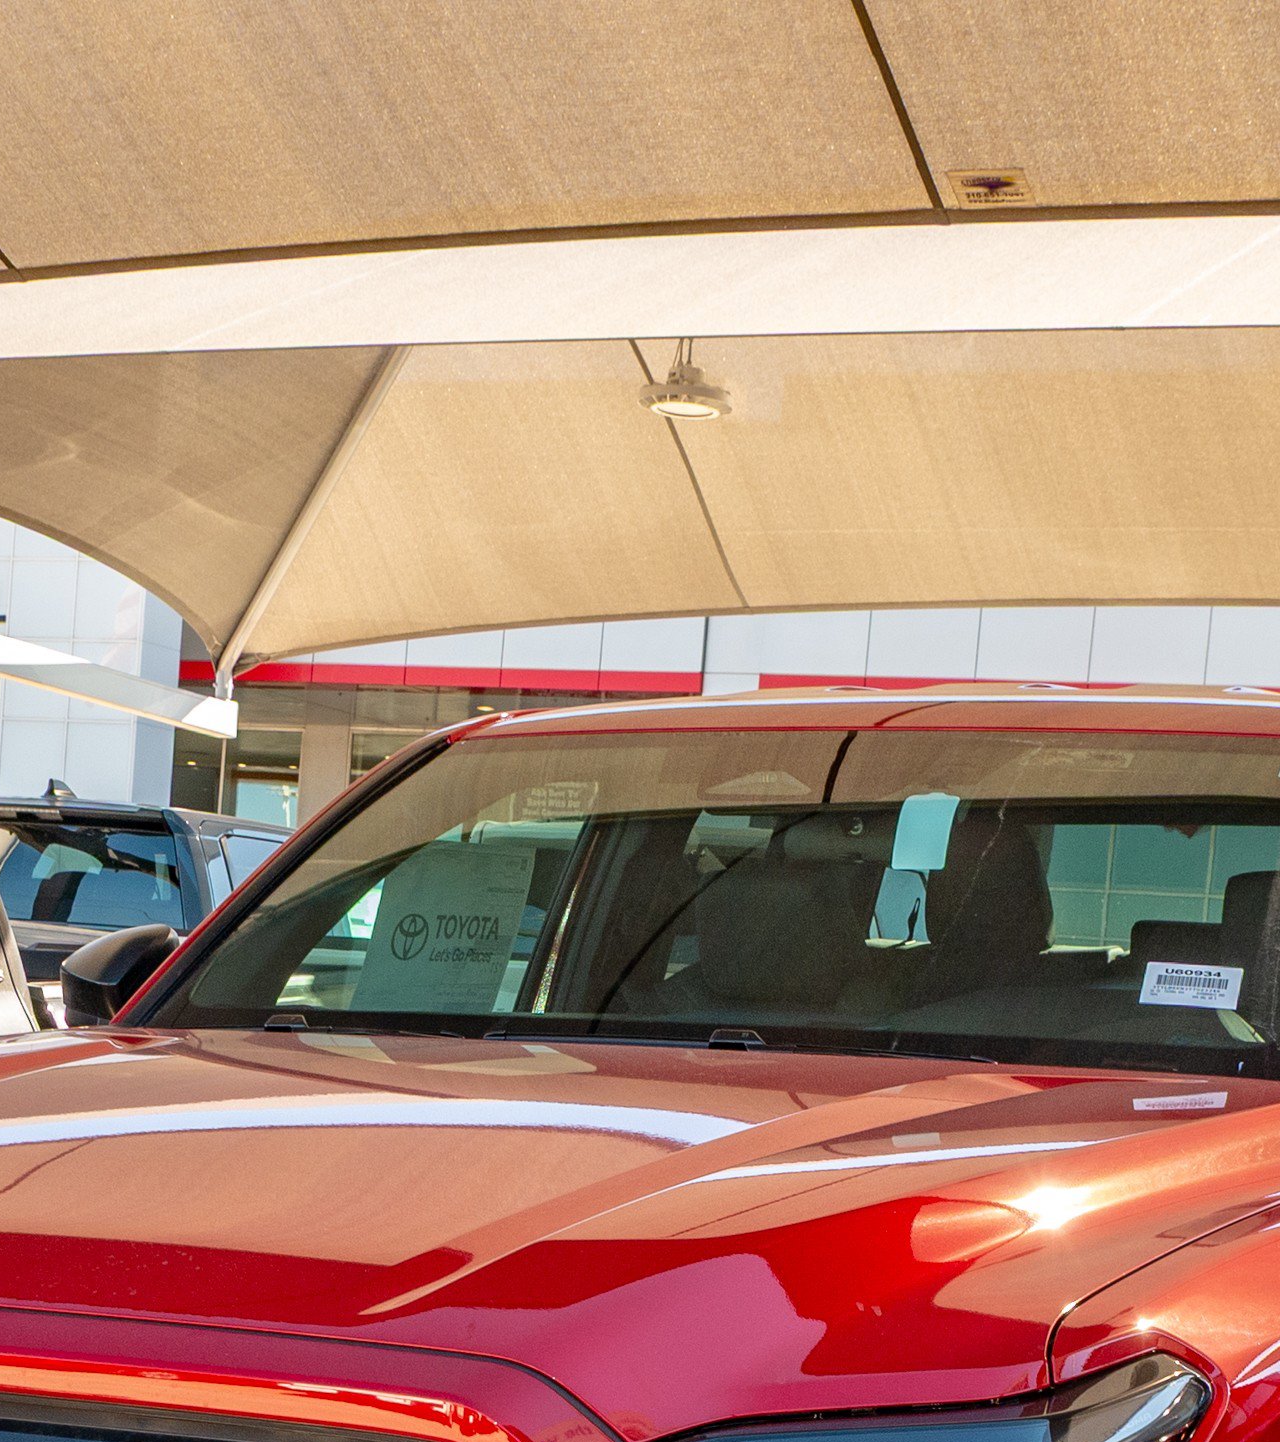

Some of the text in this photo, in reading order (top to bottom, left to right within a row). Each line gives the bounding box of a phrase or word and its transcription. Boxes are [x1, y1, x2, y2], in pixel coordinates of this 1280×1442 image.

[435, 914, 500, 941] TOYOTA
[429, 947, 450, 962] Let's
[452, 948, 466, 963] Go
[1165, 968, 1222, 978] U60934
